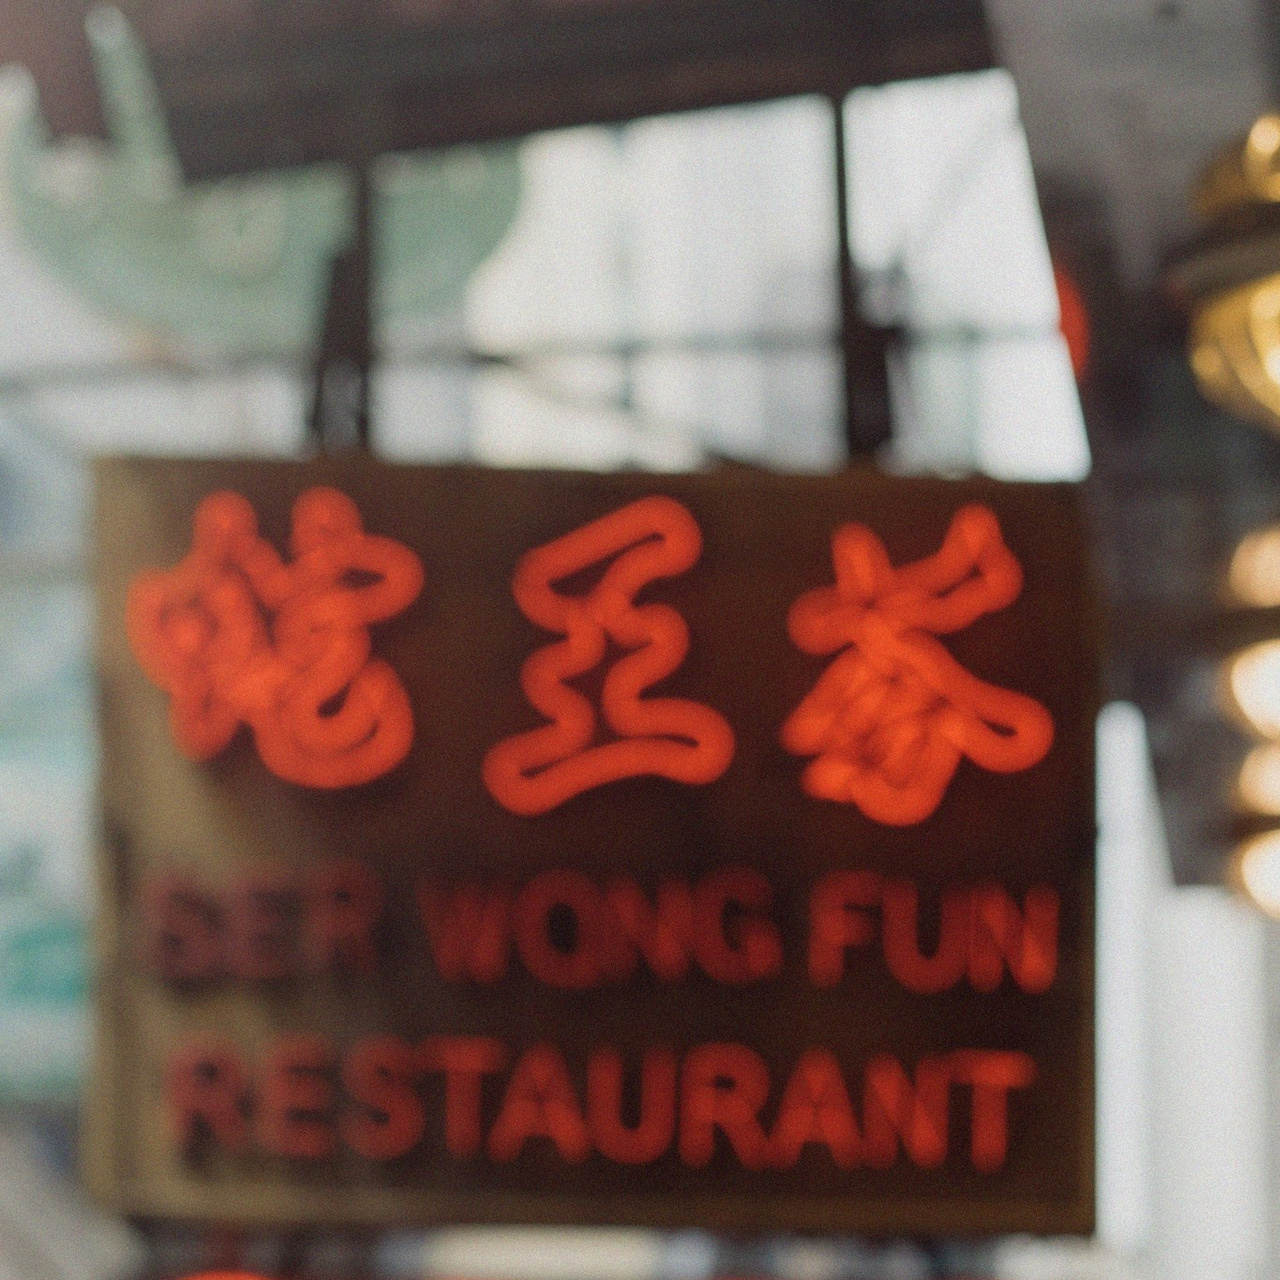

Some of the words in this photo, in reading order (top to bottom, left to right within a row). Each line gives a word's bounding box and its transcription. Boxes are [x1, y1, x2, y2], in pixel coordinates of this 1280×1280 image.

[416, 867, 784, 988] WONG
[808, 871, 1060, 993] FUN
[167, 1035, 1034, 1171] RESTAURANT
